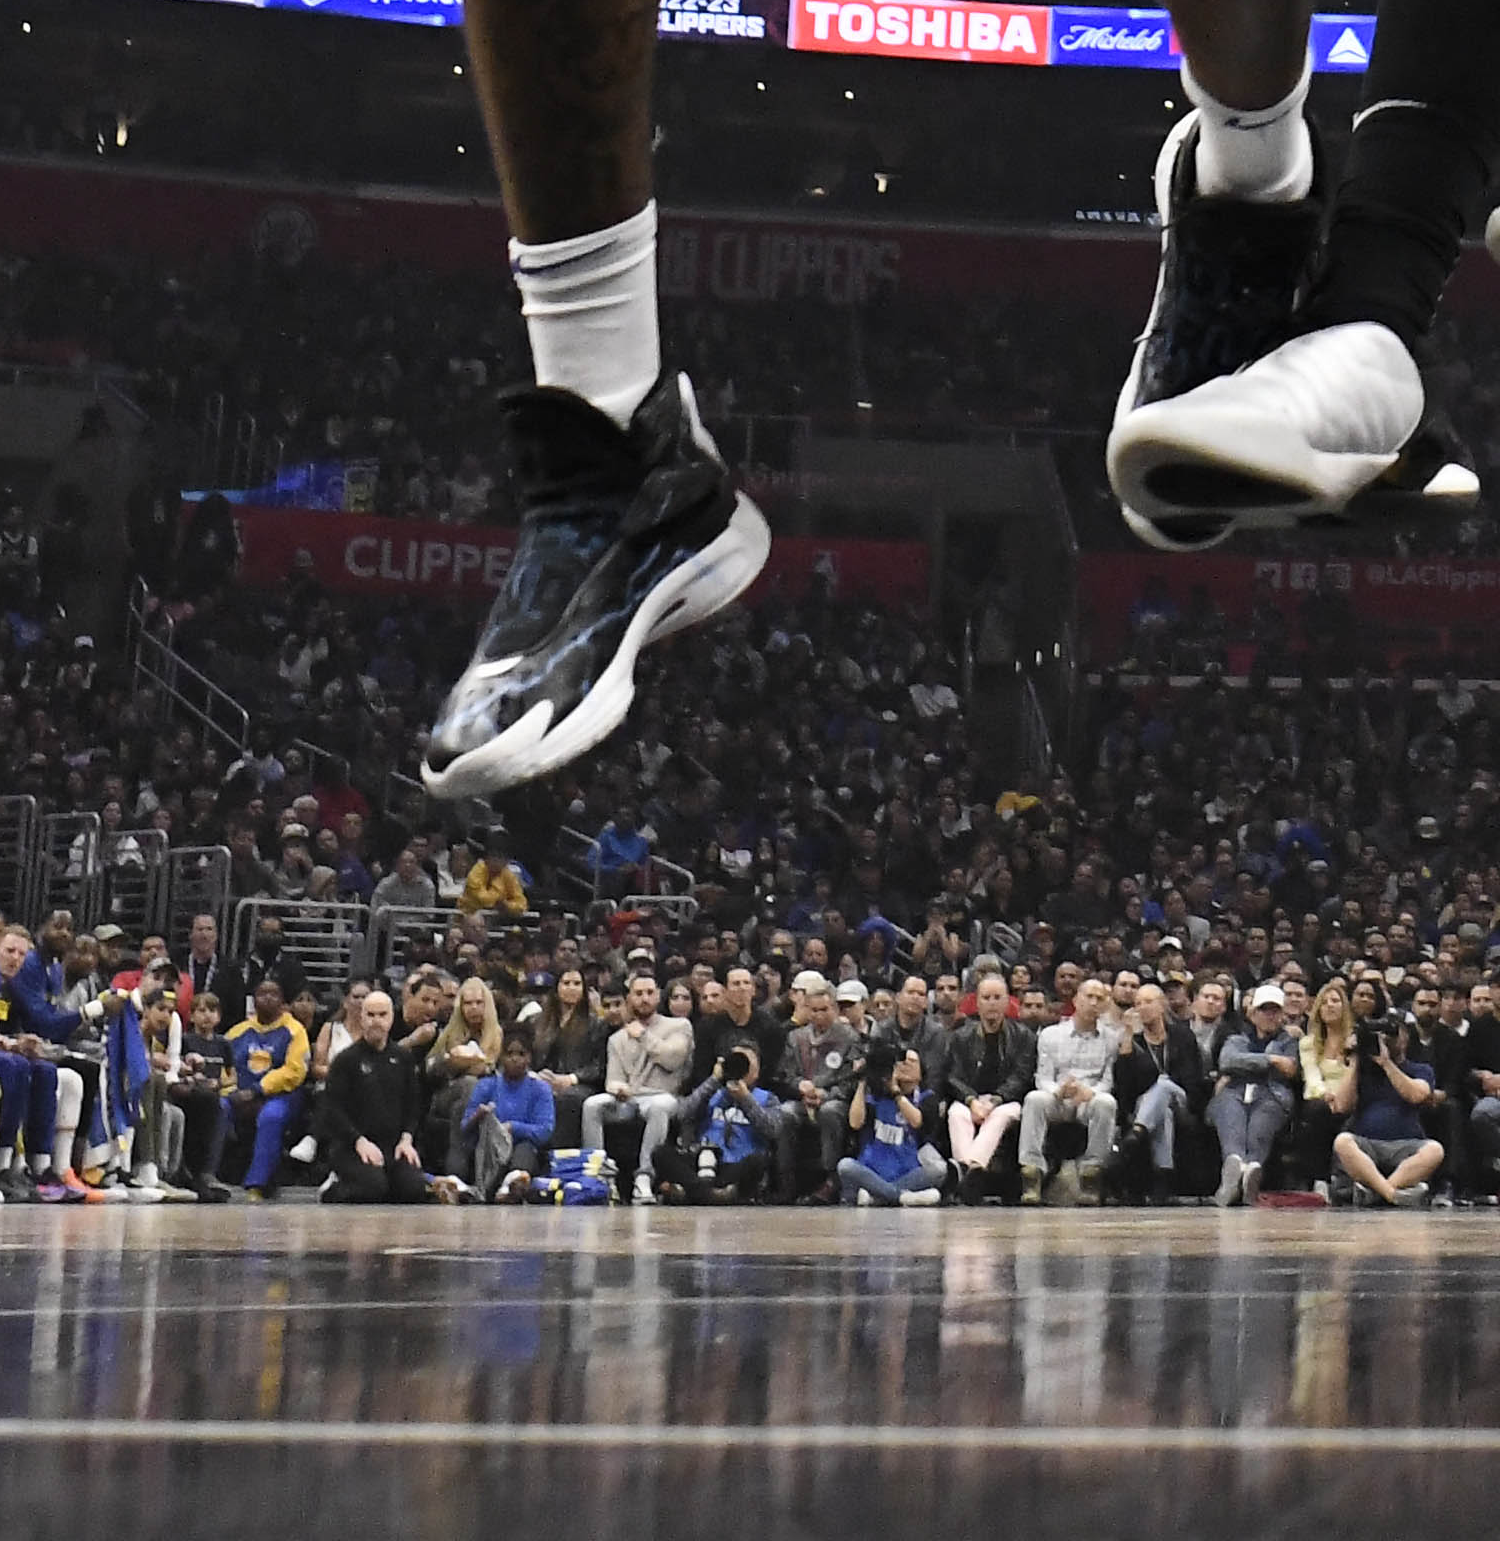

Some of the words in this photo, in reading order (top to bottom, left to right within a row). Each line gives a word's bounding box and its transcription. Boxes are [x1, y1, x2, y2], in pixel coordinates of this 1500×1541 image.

[656, 11, 765, 38] LIPPERS
[804, 0, 1038, 54] TOSHIBA
[343, 533, 512, 588] CLIPPE
